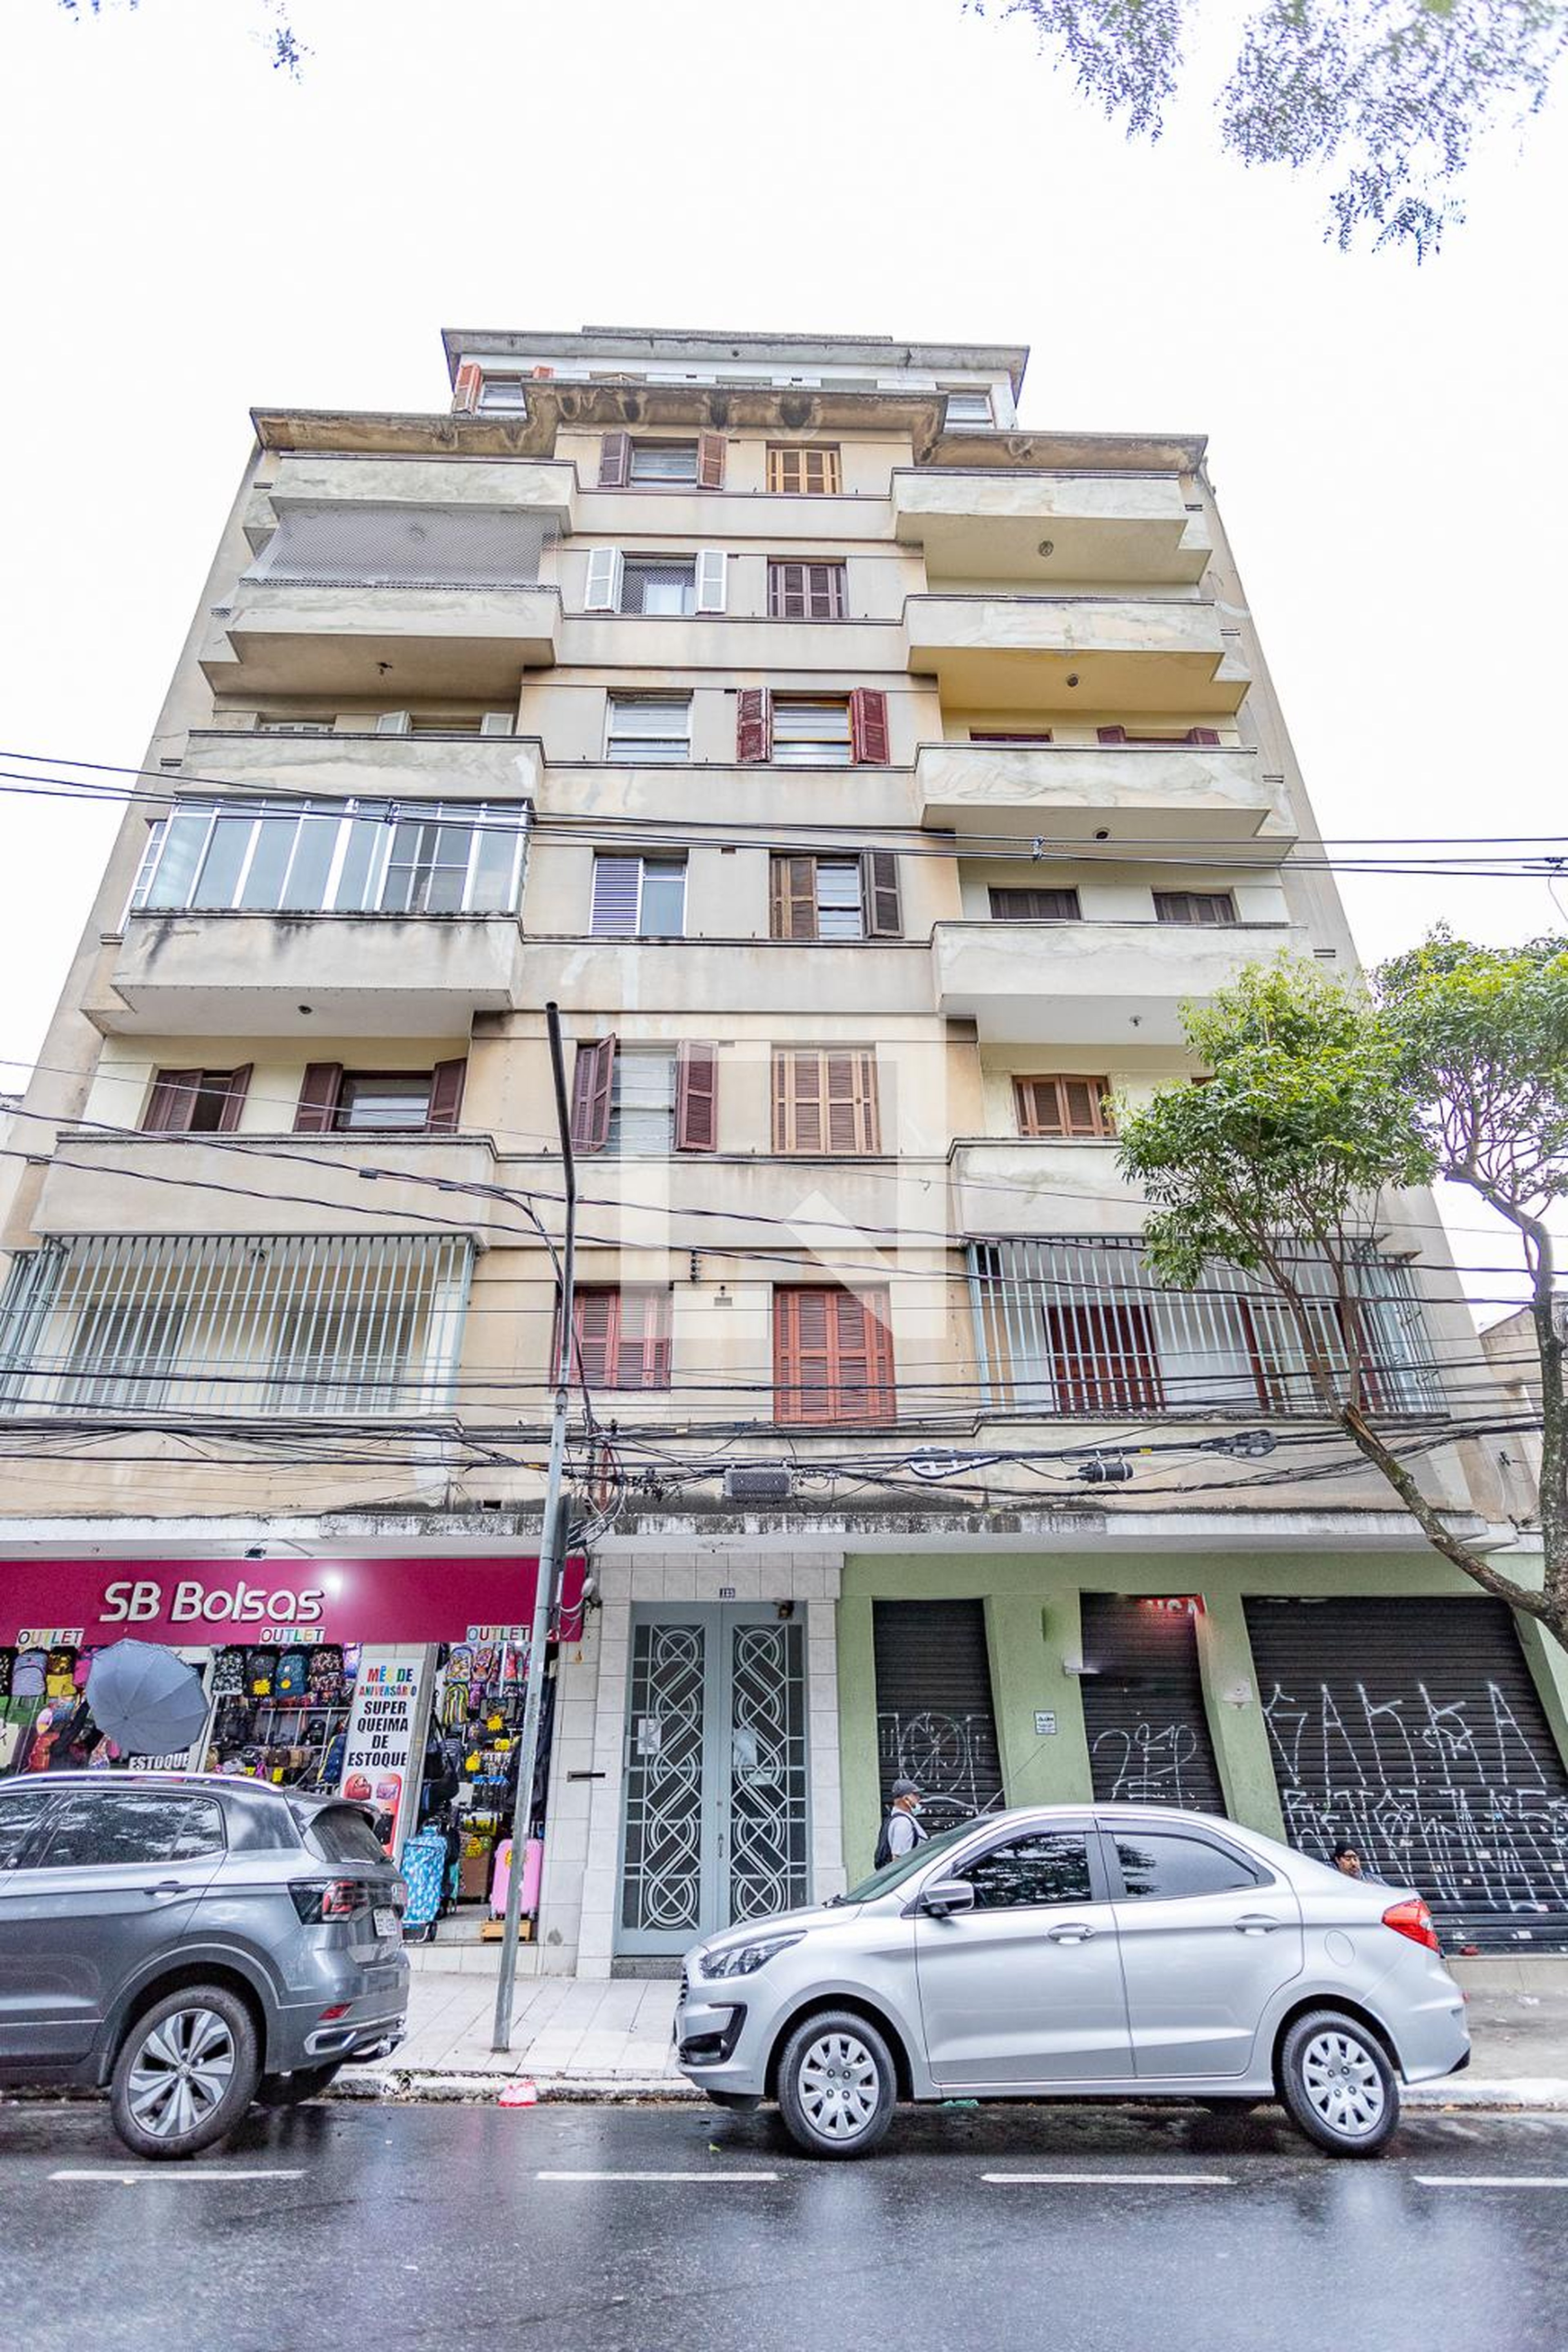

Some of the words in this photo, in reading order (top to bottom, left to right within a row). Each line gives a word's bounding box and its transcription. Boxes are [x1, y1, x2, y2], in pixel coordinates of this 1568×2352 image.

[99, 1581, 162, 1622] SB
[171, 1581, 324, 1622] Bolsas
[18, 1630, 83, 1644] OUTLET
[261, 1629, 324, 1642] OUTLET
[468, 1627, 529, 1641] OUTLET
[396, 1668, 413, 1682] DE
[364, 1701, 407, 1715] SUPER
[357, 1717, 408, 1733] QUEIMA
[371, 1735, 389, 1749] DE
[347, 1751, 408, 1768] ESTOQUE
